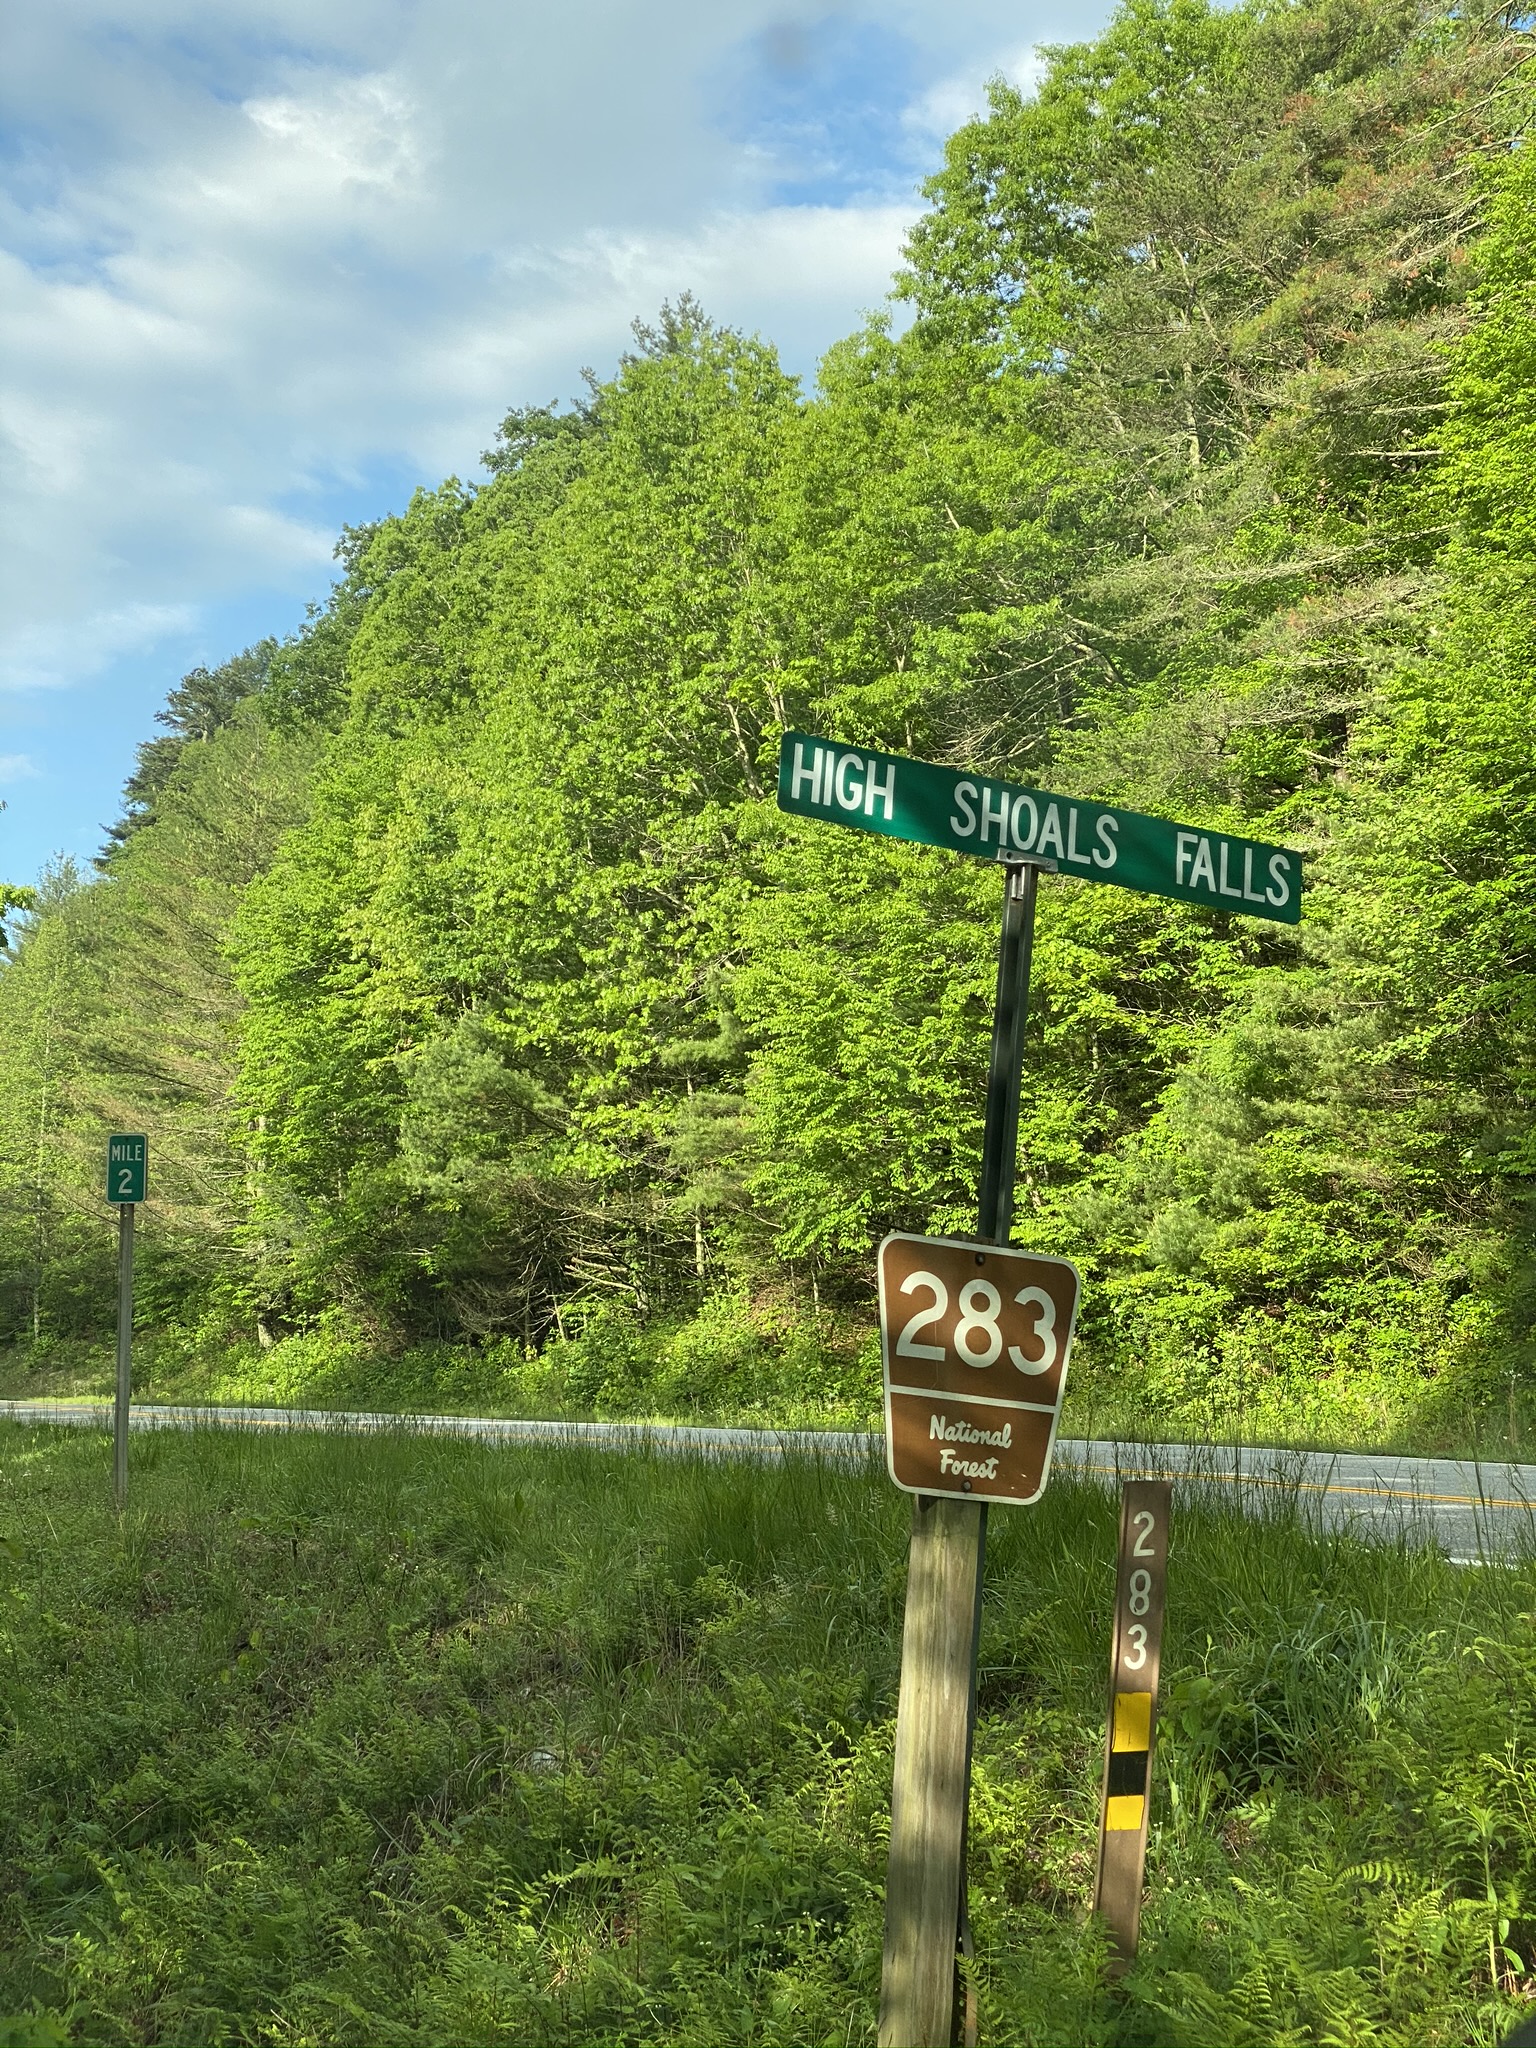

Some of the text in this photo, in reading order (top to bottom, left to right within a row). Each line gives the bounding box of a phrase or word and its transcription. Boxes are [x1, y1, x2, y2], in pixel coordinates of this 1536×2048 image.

[791, 742, 1291, 906] HIGH SHOALS FALLS
[111, 1144, 142, 1162] MILE
[118, 1168, 133, 1194] 2
[896, 1270, 1057, 1376] 283
[929, 1414, 1012, 1449] National
[939, 1449, 999, 1480] Forest
[1123, 1510, 1155, 1670] 283
